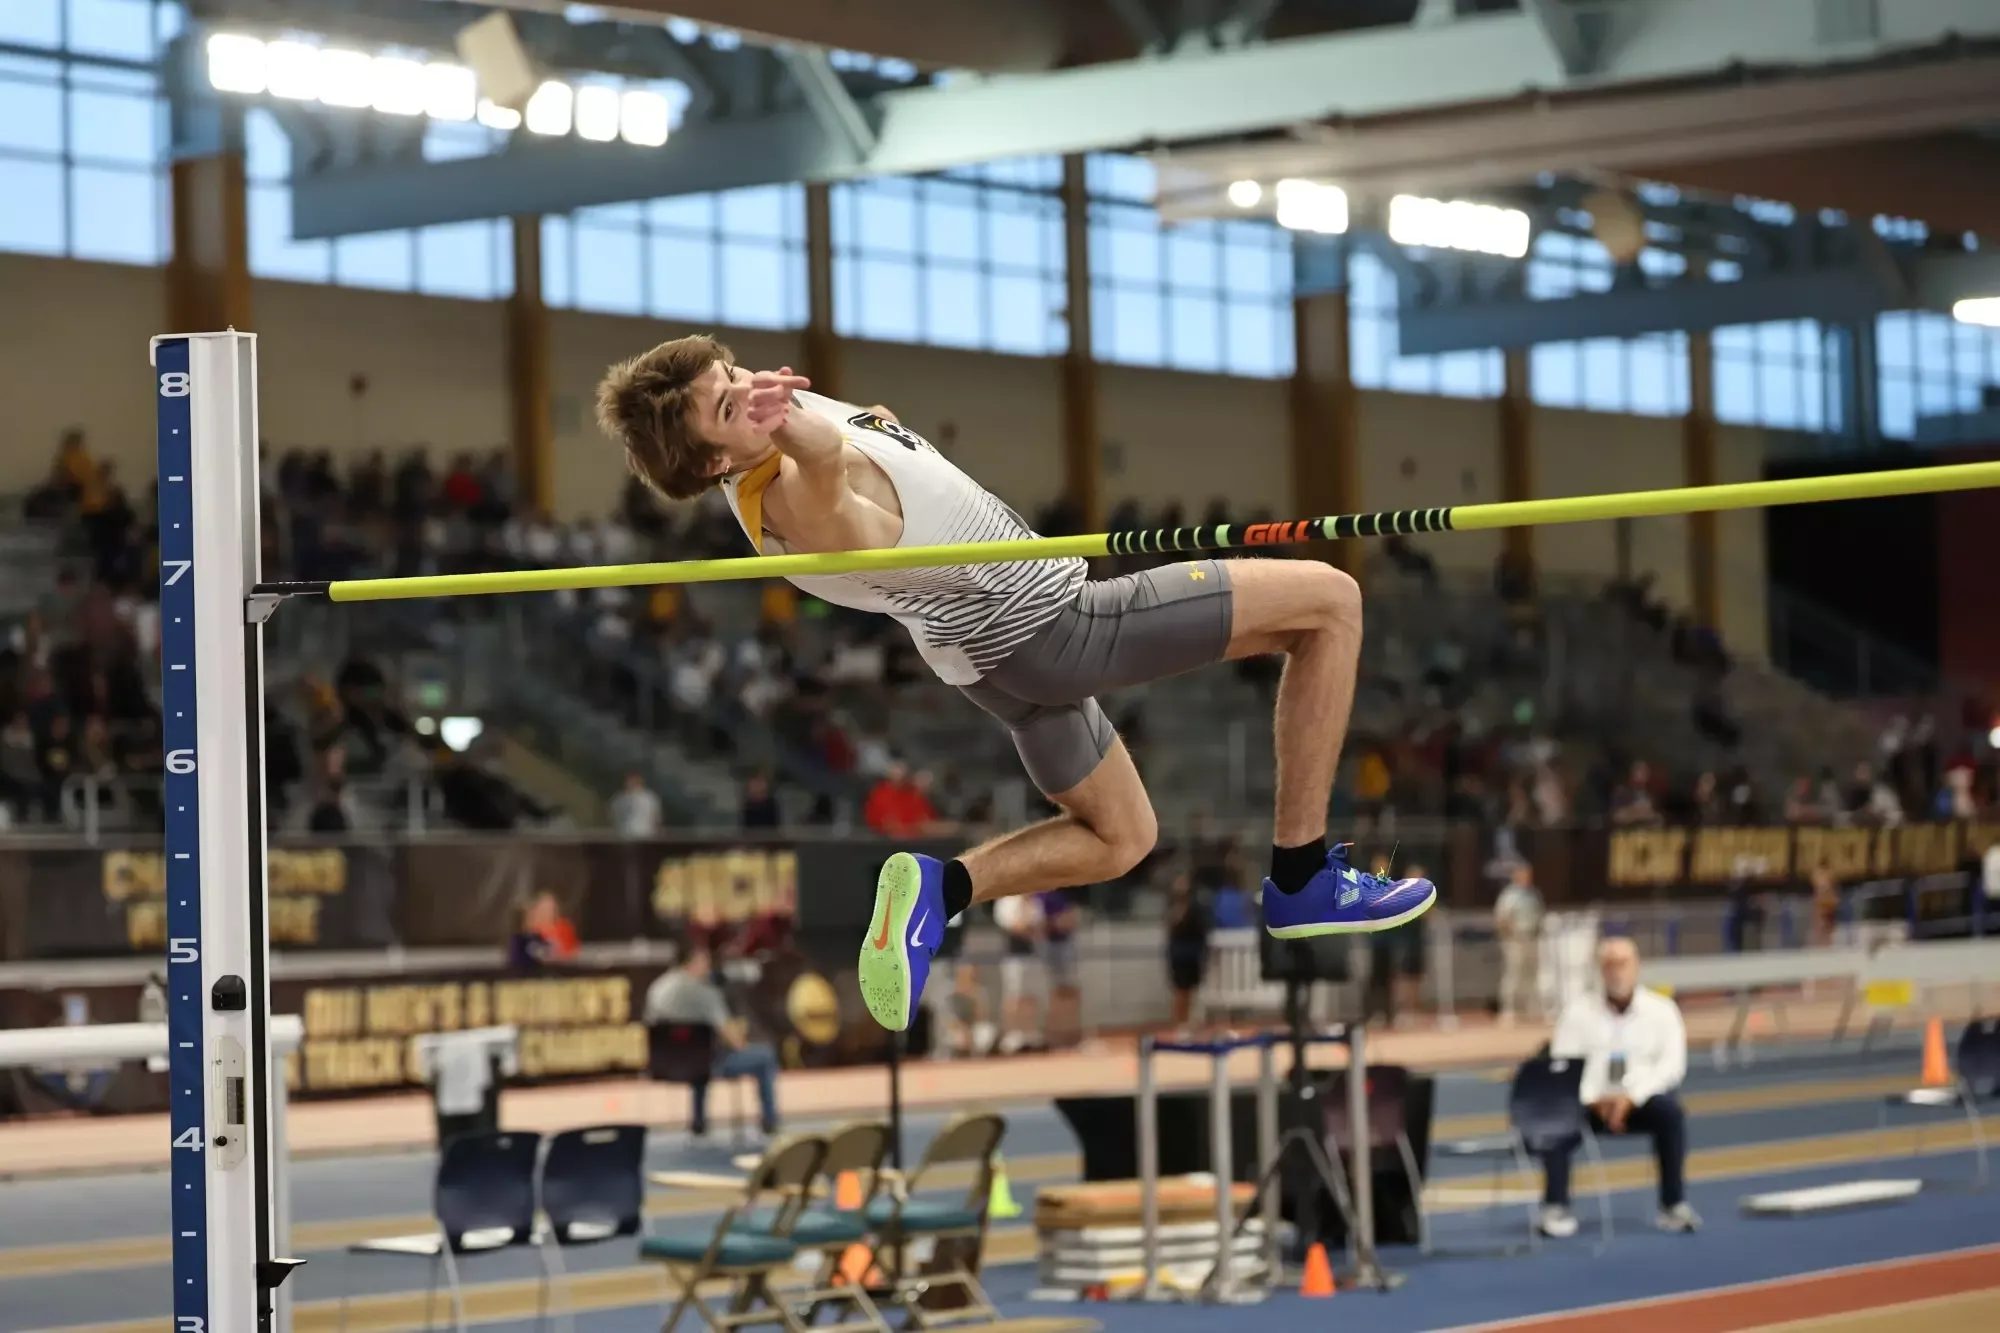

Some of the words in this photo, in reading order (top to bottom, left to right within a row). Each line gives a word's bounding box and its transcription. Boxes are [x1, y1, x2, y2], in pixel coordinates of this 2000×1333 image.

[160, 372, 190, 397] 8
[1243, 520, 1310, 545] GILL
[162, 560, 192, 586] 7
[165, 748, 196, 774] 6
[170, 938, 199, 963] 5
[172, 1126, 205, 1152] 4
[177, 1316, 204, 1333] 3
